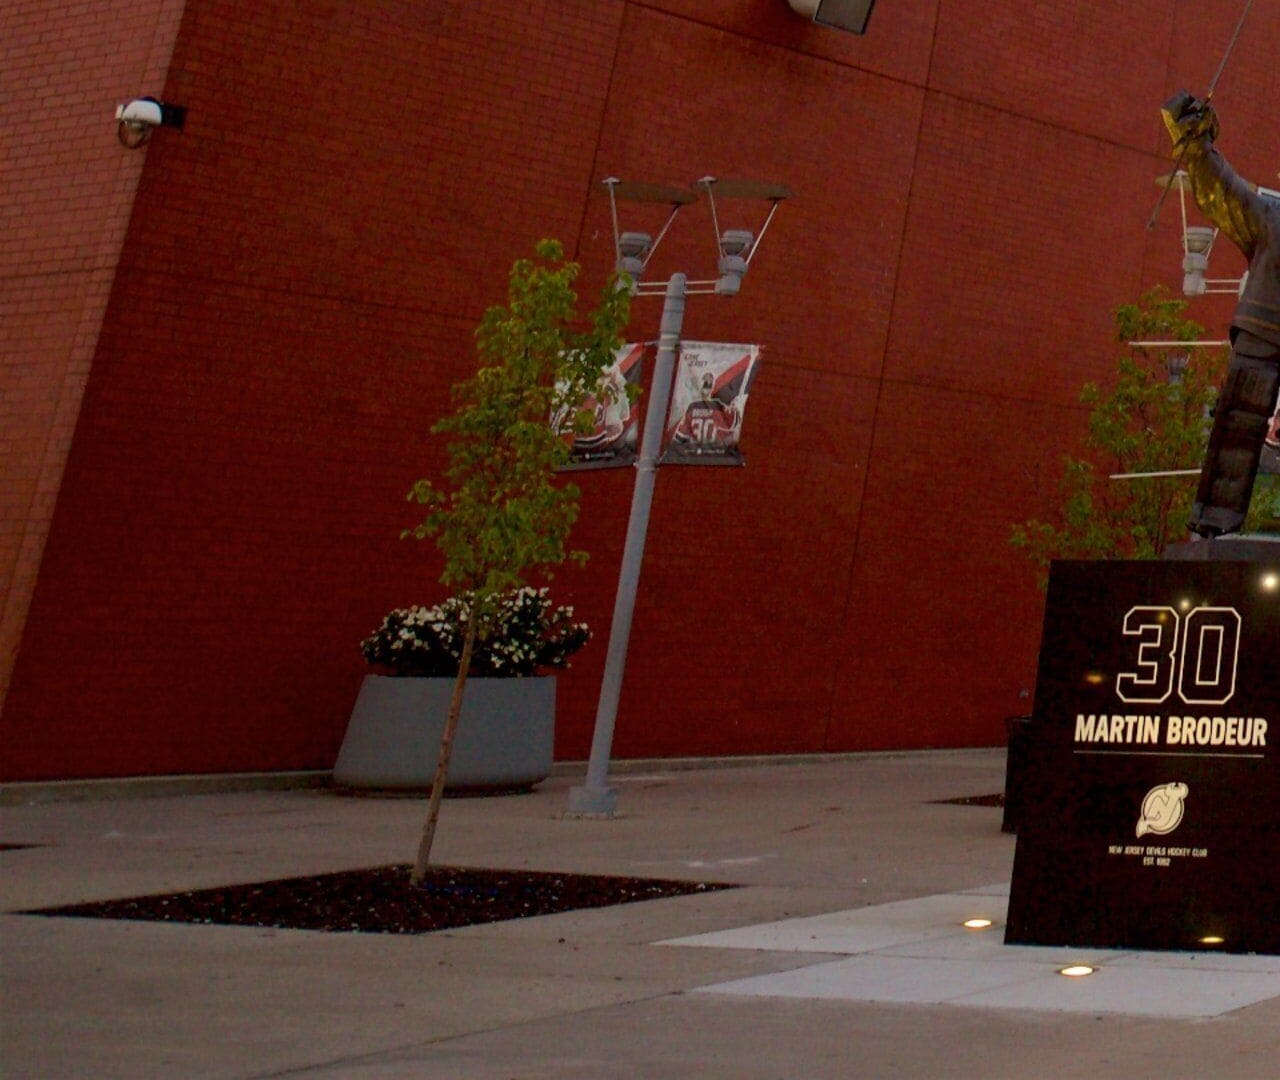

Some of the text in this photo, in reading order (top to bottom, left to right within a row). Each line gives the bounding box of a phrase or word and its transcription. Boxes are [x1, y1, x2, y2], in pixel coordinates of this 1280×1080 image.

[1116, 606, 1241, 705] 30
[1074, 714, 1268, 746] MARTIN BRODEUR
[1108, 845, 1123, 854] NEW
